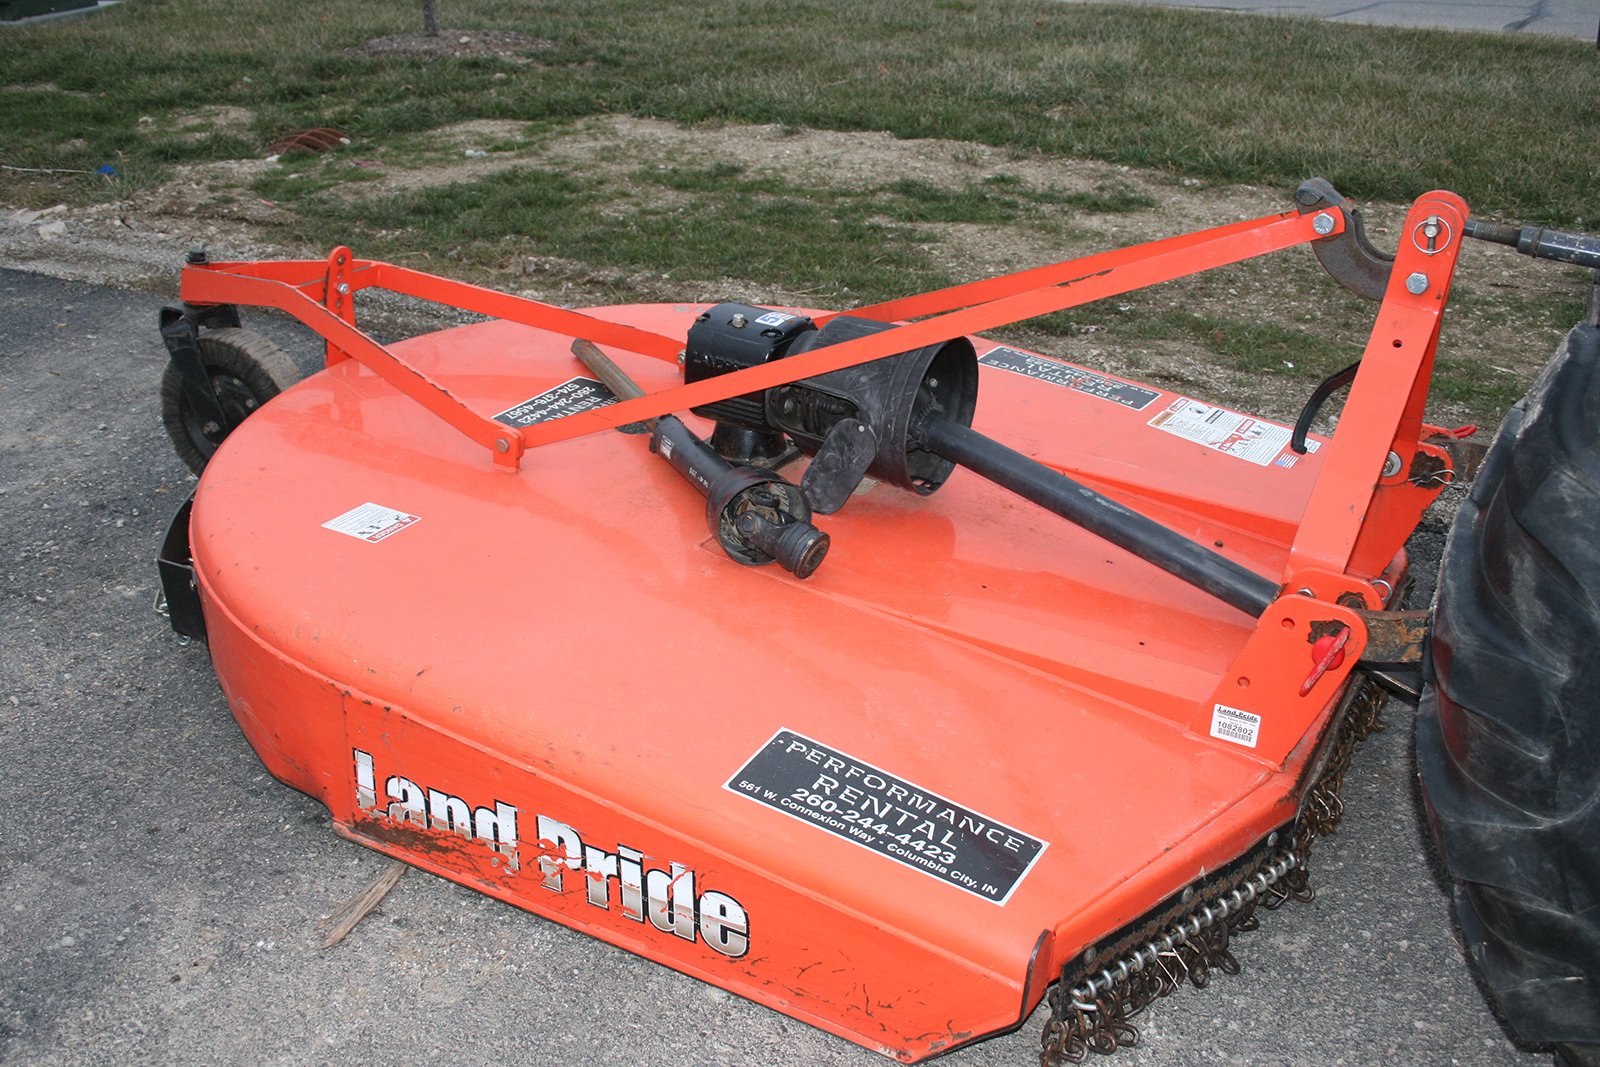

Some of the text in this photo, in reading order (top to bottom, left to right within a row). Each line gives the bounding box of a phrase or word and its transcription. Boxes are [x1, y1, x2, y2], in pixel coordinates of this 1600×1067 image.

[517, 386, 596, 424] 260-244-4423
[986, 358, 1134, 406] PERFORMANCE
[1027, 363, 1113, 392] RENTAL
[1217, 720, 1254, 736] 1082802
[1218, 706, 1237, 717] Land
[1238, 711, 1259, 722] Pride
[785, 740, 1025, 853] PERFORMANCE
[790, 788, 957, 865] 260-244-4423
[811, 773, 957, 851] RENTAL
[352, 747, 751, 958] Land Pride
[738, 780, 998, 895] 561 W. Connexion Way Columbia City, IN
